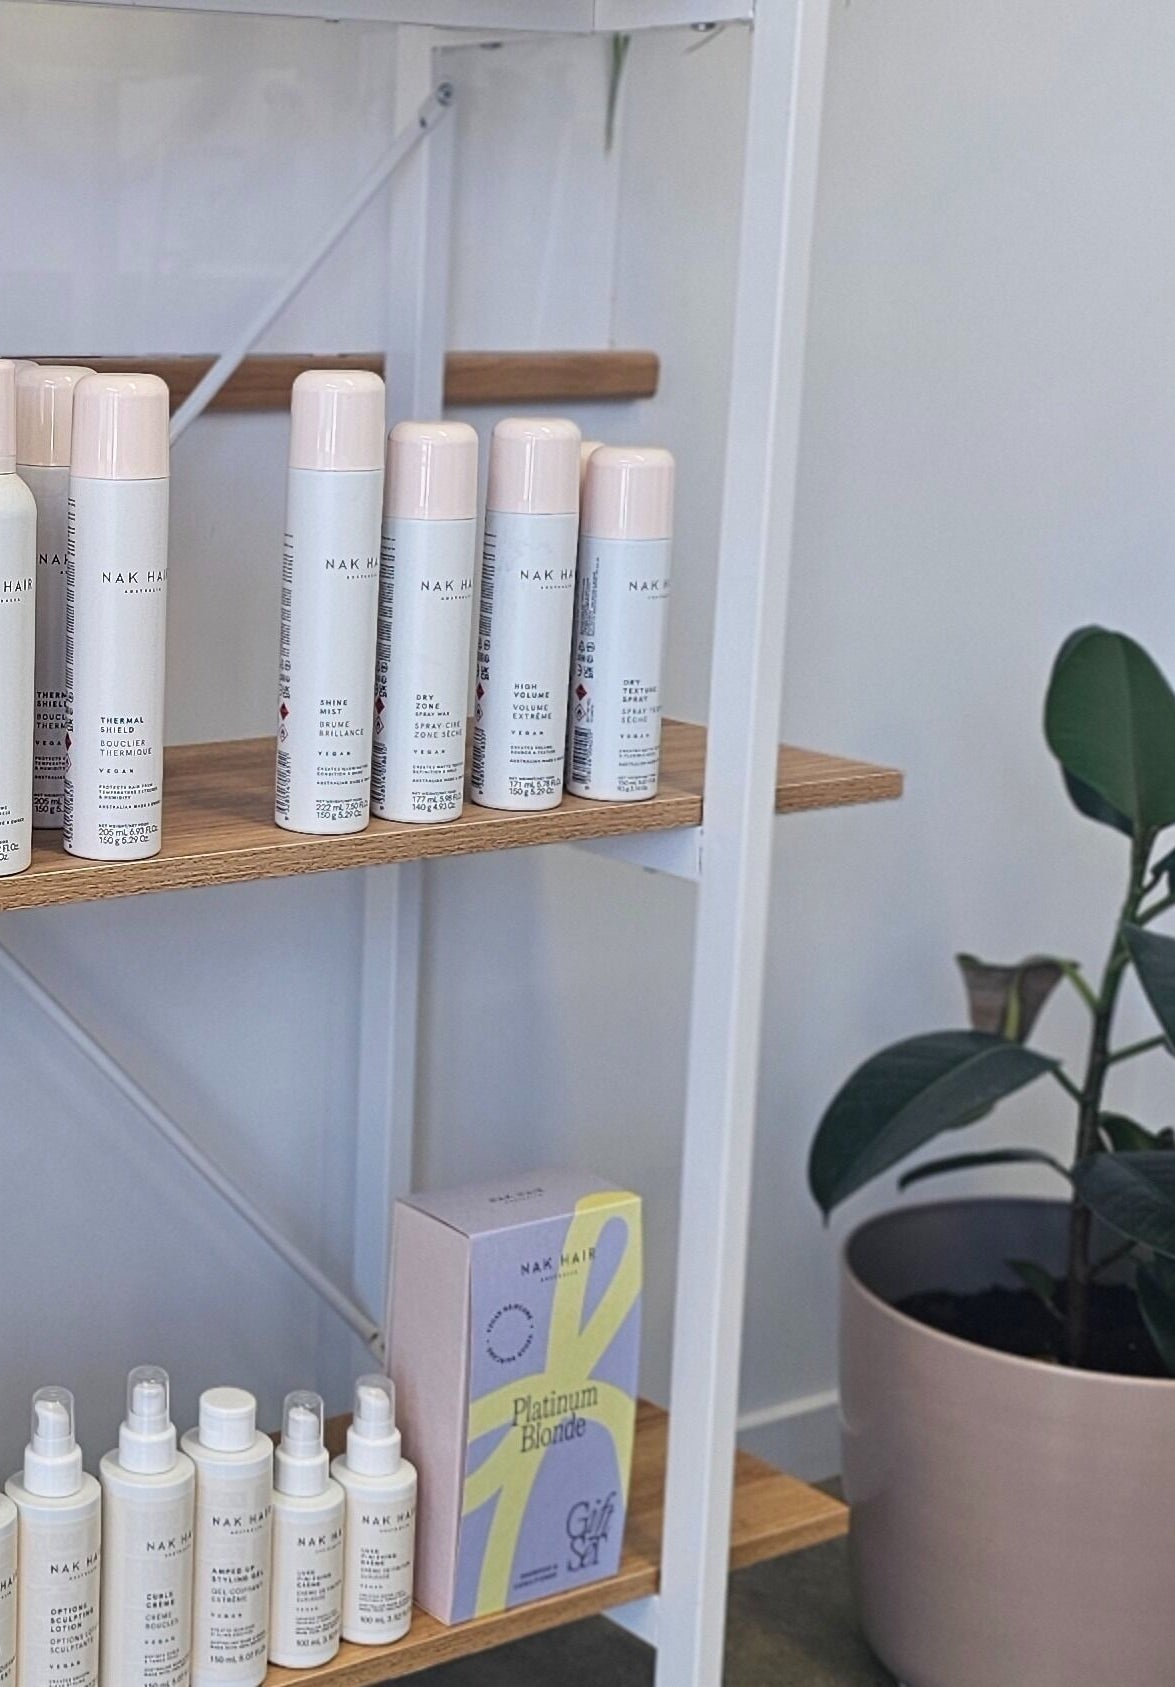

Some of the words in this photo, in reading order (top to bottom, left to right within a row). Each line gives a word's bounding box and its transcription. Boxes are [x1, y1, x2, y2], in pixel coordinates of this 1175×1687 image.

[325, 558, 359, 570] NAK
[102, 571, 138, 583] NAK
[520, 569, 554, 580] NAK
[3, 578, 32, 593] HAIR
[421, 580, 454, 592] NAK
[629, 579, 659, 591] NAK
[623, 686, 656, 694] TEXTURE
[415, 702, 440, 710] ZONE
[100, 716, 144, 724] THERMAL
[319, 728, 364, 737] BRILLANCE
[100, 748, 152, 756] THERMIQUE
[509, 787, 523, 795] 150
[316, 803, 331, 811] 222
[99, 828, 113, 836] 205
[129, 827, 144, 835] 6.93
[99, 836, 113, 844] 150
[521, 1256, 552, 1276] NAK
[560, 1247, 596, 1267] HAIR
[511, 1386, 599, 1427] Platinum
[519, 1411, 586, 1454] Blonde
[362, 1515, 390, 1525] NAK
[566, 1491, 617, 1540] Gift
[212, 1516, 242, 1526] NAK
[146, 1539, 175, 1551] NAK
[297, 1536, 326, 1546] NAK
[51, 1561, 80, 1574] NAK
[212, 1575, 248, 1583] STYLING
[146, 1591, 173, 1600] CURLS
[50, 1603, 87, 1615] OPTIONS
[50, 1607, 93, 1624] SCULPTING
[50, 1622, 82, 1632] LOTION
[145, 1617, 179, 1629] BOUCLES
[210, 1655, 224, 1663] 150
